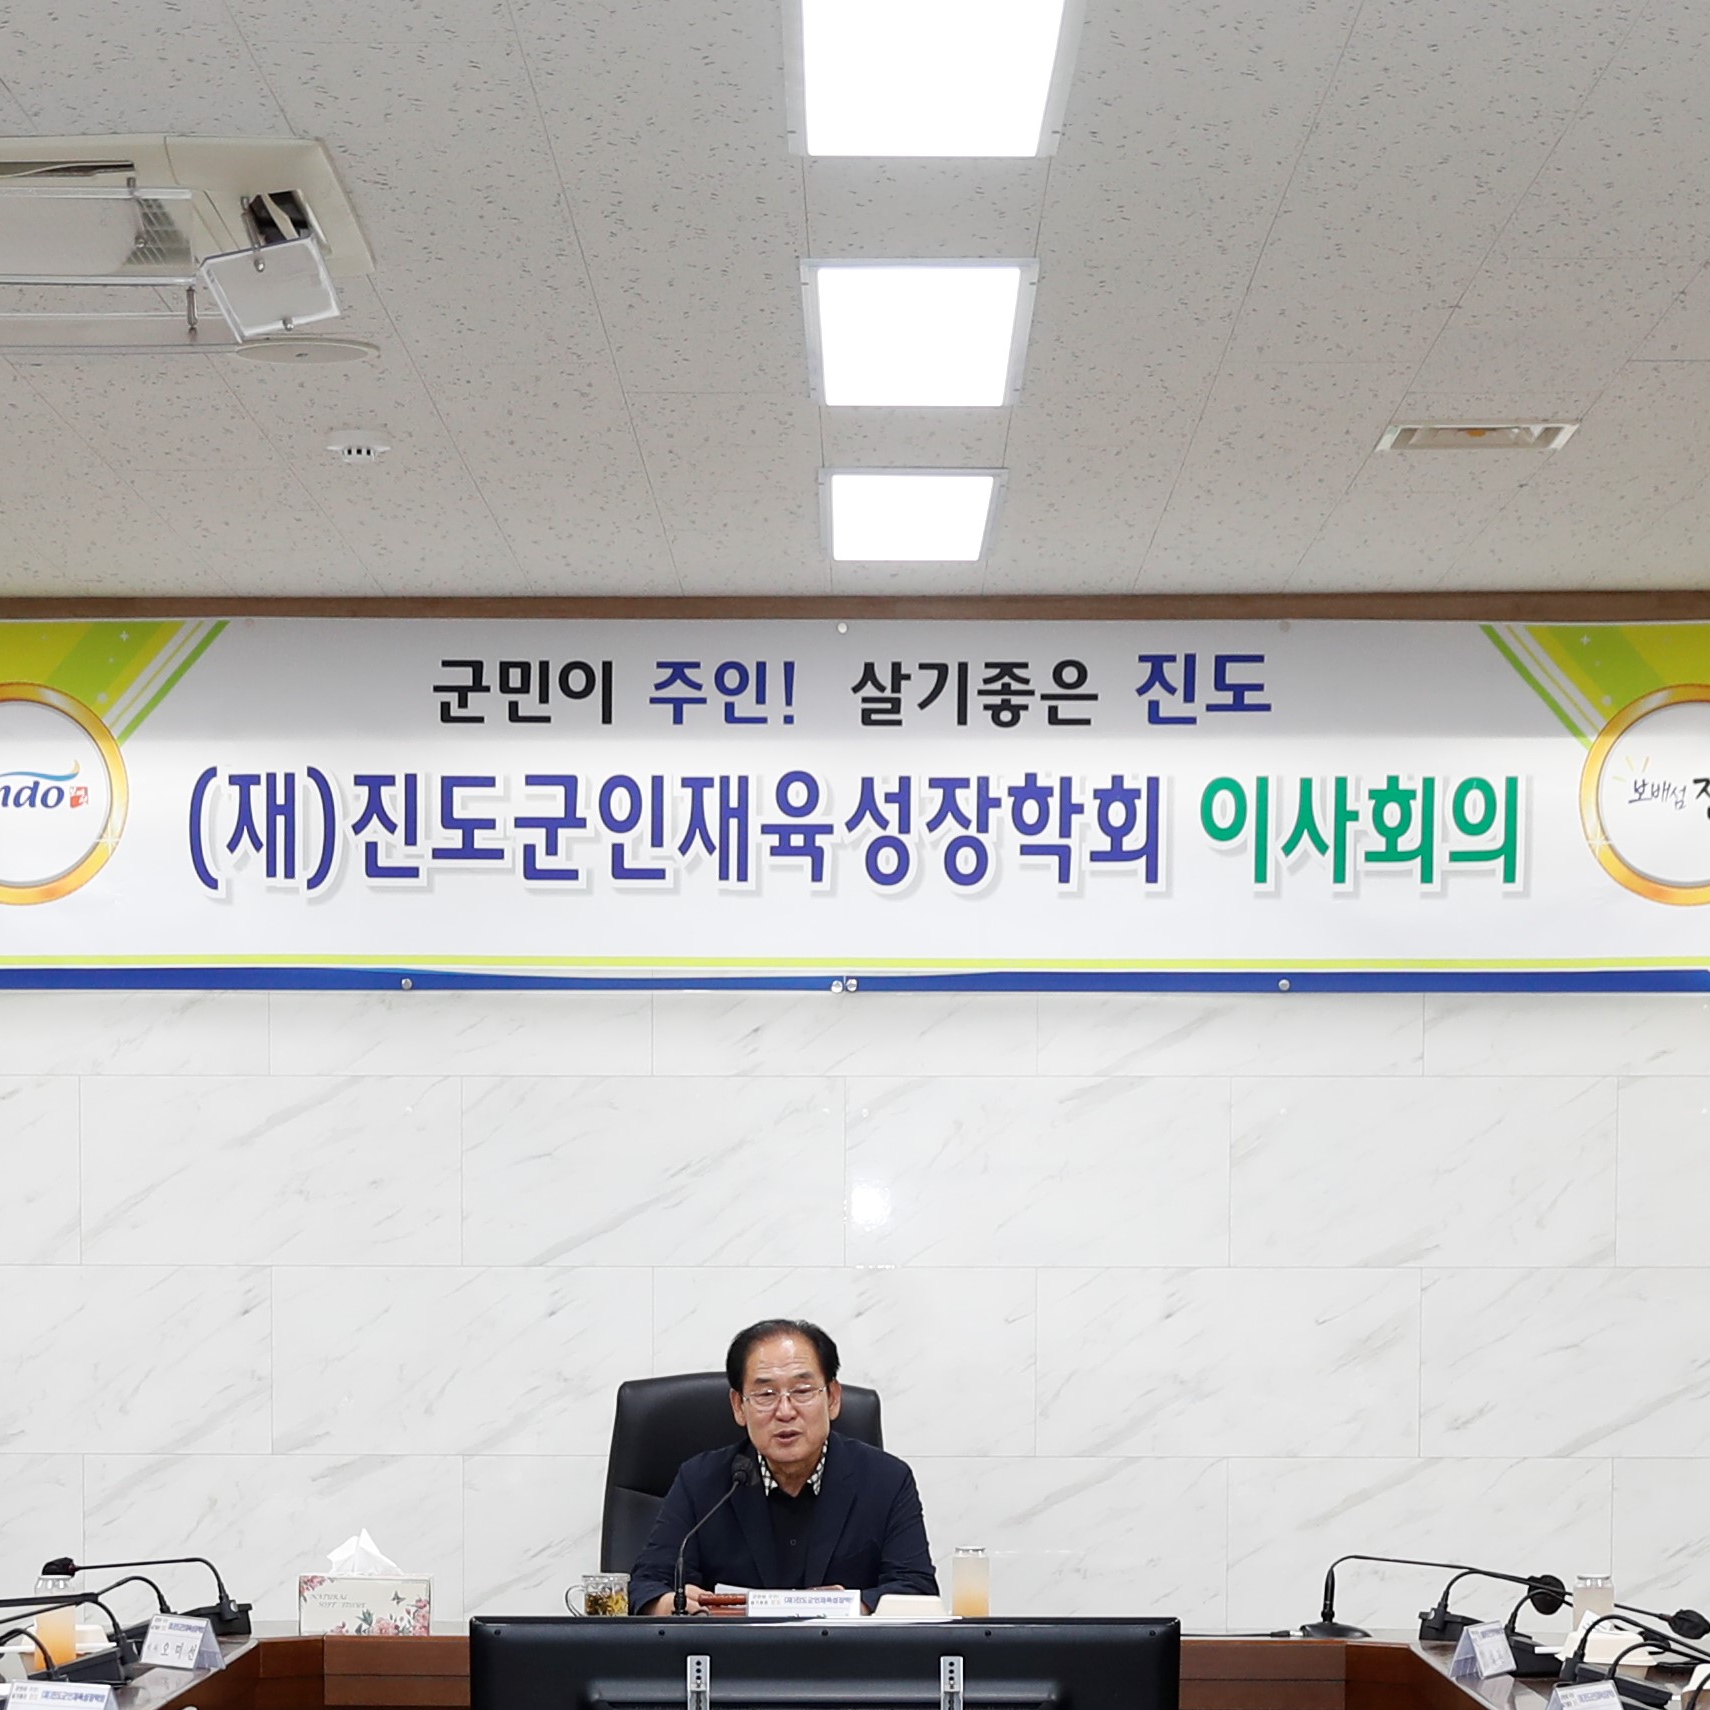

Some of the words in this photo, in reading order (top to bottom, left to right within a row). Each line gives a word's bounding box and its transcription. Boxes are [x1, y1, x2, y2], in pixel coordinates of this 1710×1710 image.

[433, 659, 613, 724] 군민이
[649, 660, 795, 725] 주인!
[851, 659, 1099, 727] 살기좋은
[1135, 652, 1272, 726] 진도
[188, 764, 1160, 891] (재)진도군인재육성장학회
[1200, 774, 1519, 885] 이사회의
[1627, 778, 1687, 810] 보배섬
